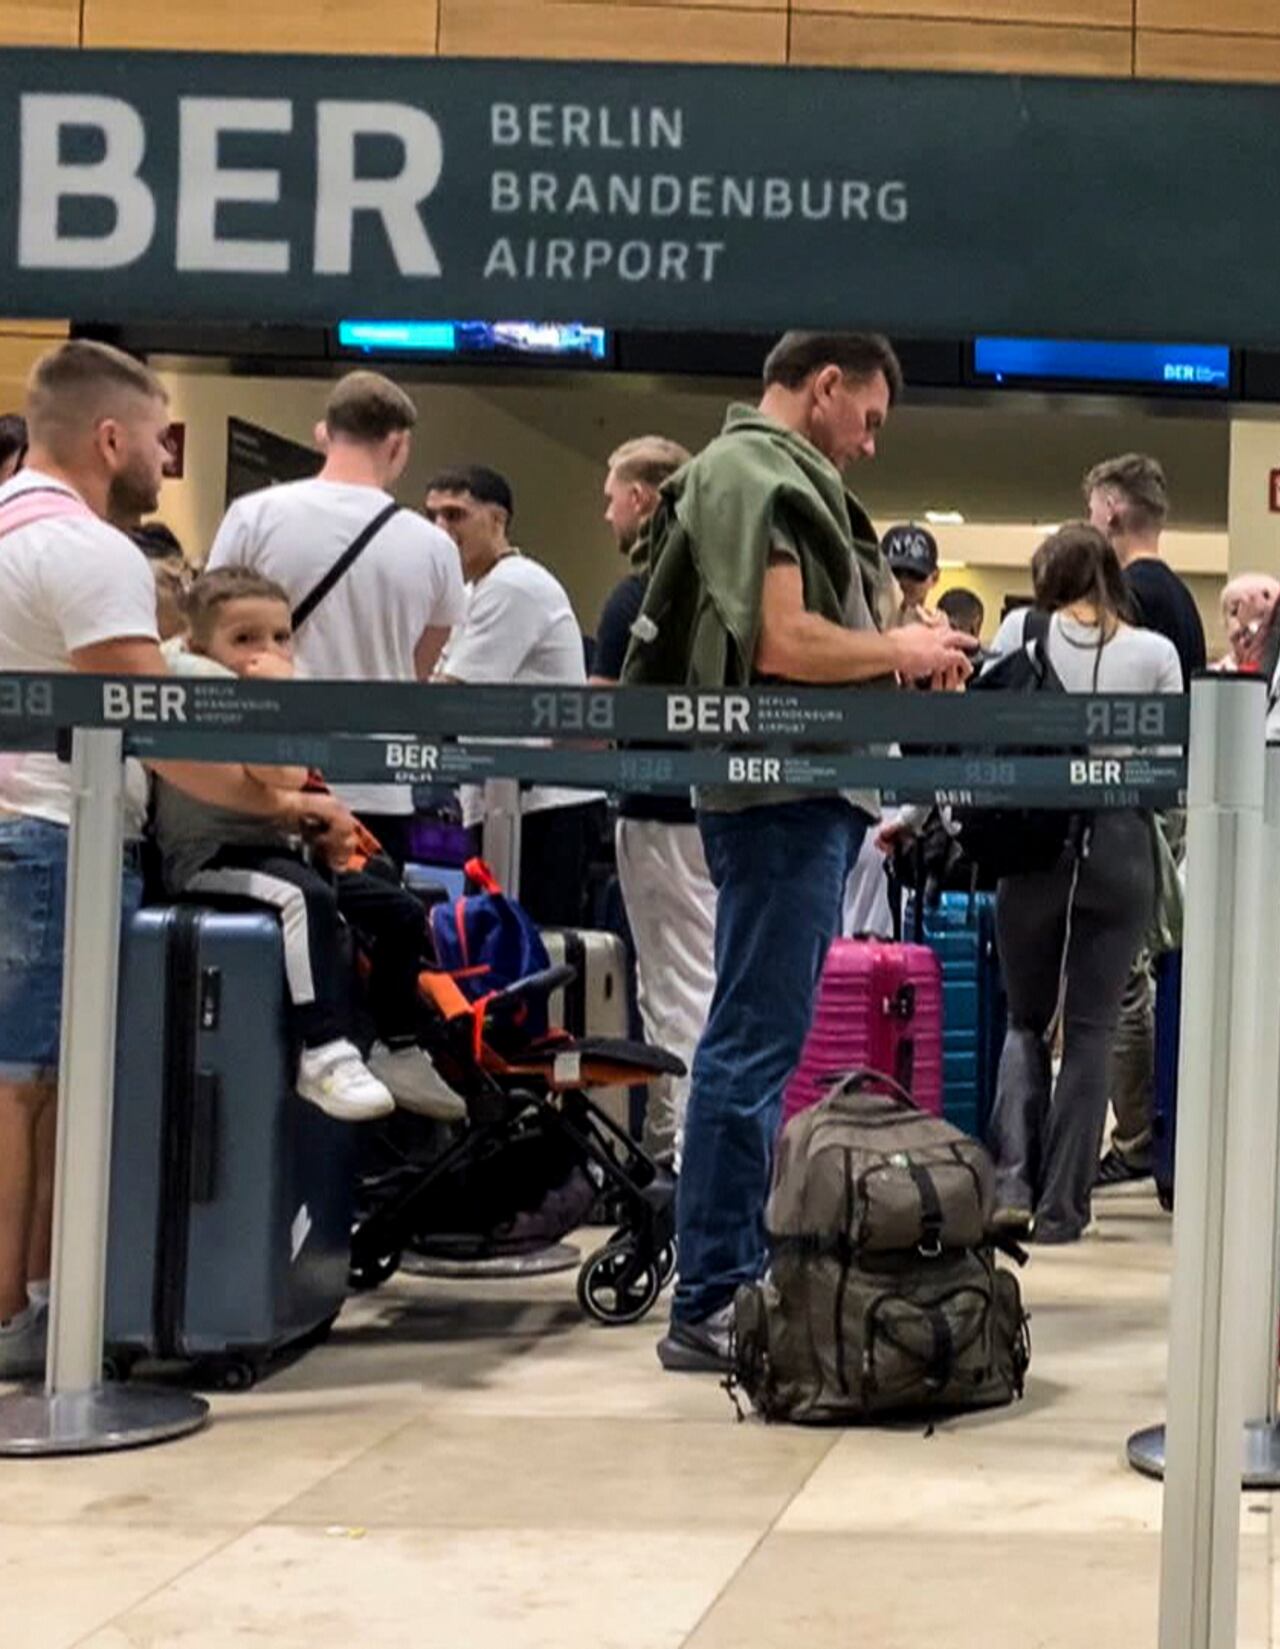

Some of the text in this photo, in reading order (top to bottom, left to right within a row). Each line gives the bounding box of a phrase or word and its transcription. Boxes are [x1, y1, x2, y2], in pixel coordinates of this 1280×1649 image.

[490, 104, 684, 149] BERLIN
[17, 92, 444, 277] BER
[490, 171, 909, 222] BRANDENBURG
[484, 240, 726, 282] AIRPORT
[103, 682, 187, 722] BER
[666, 695, 751, 733] BER
[386, 743, 438, 770] BER
[728, 757, 781, 783] BER
[1070, 759, 1122, 785] BER
